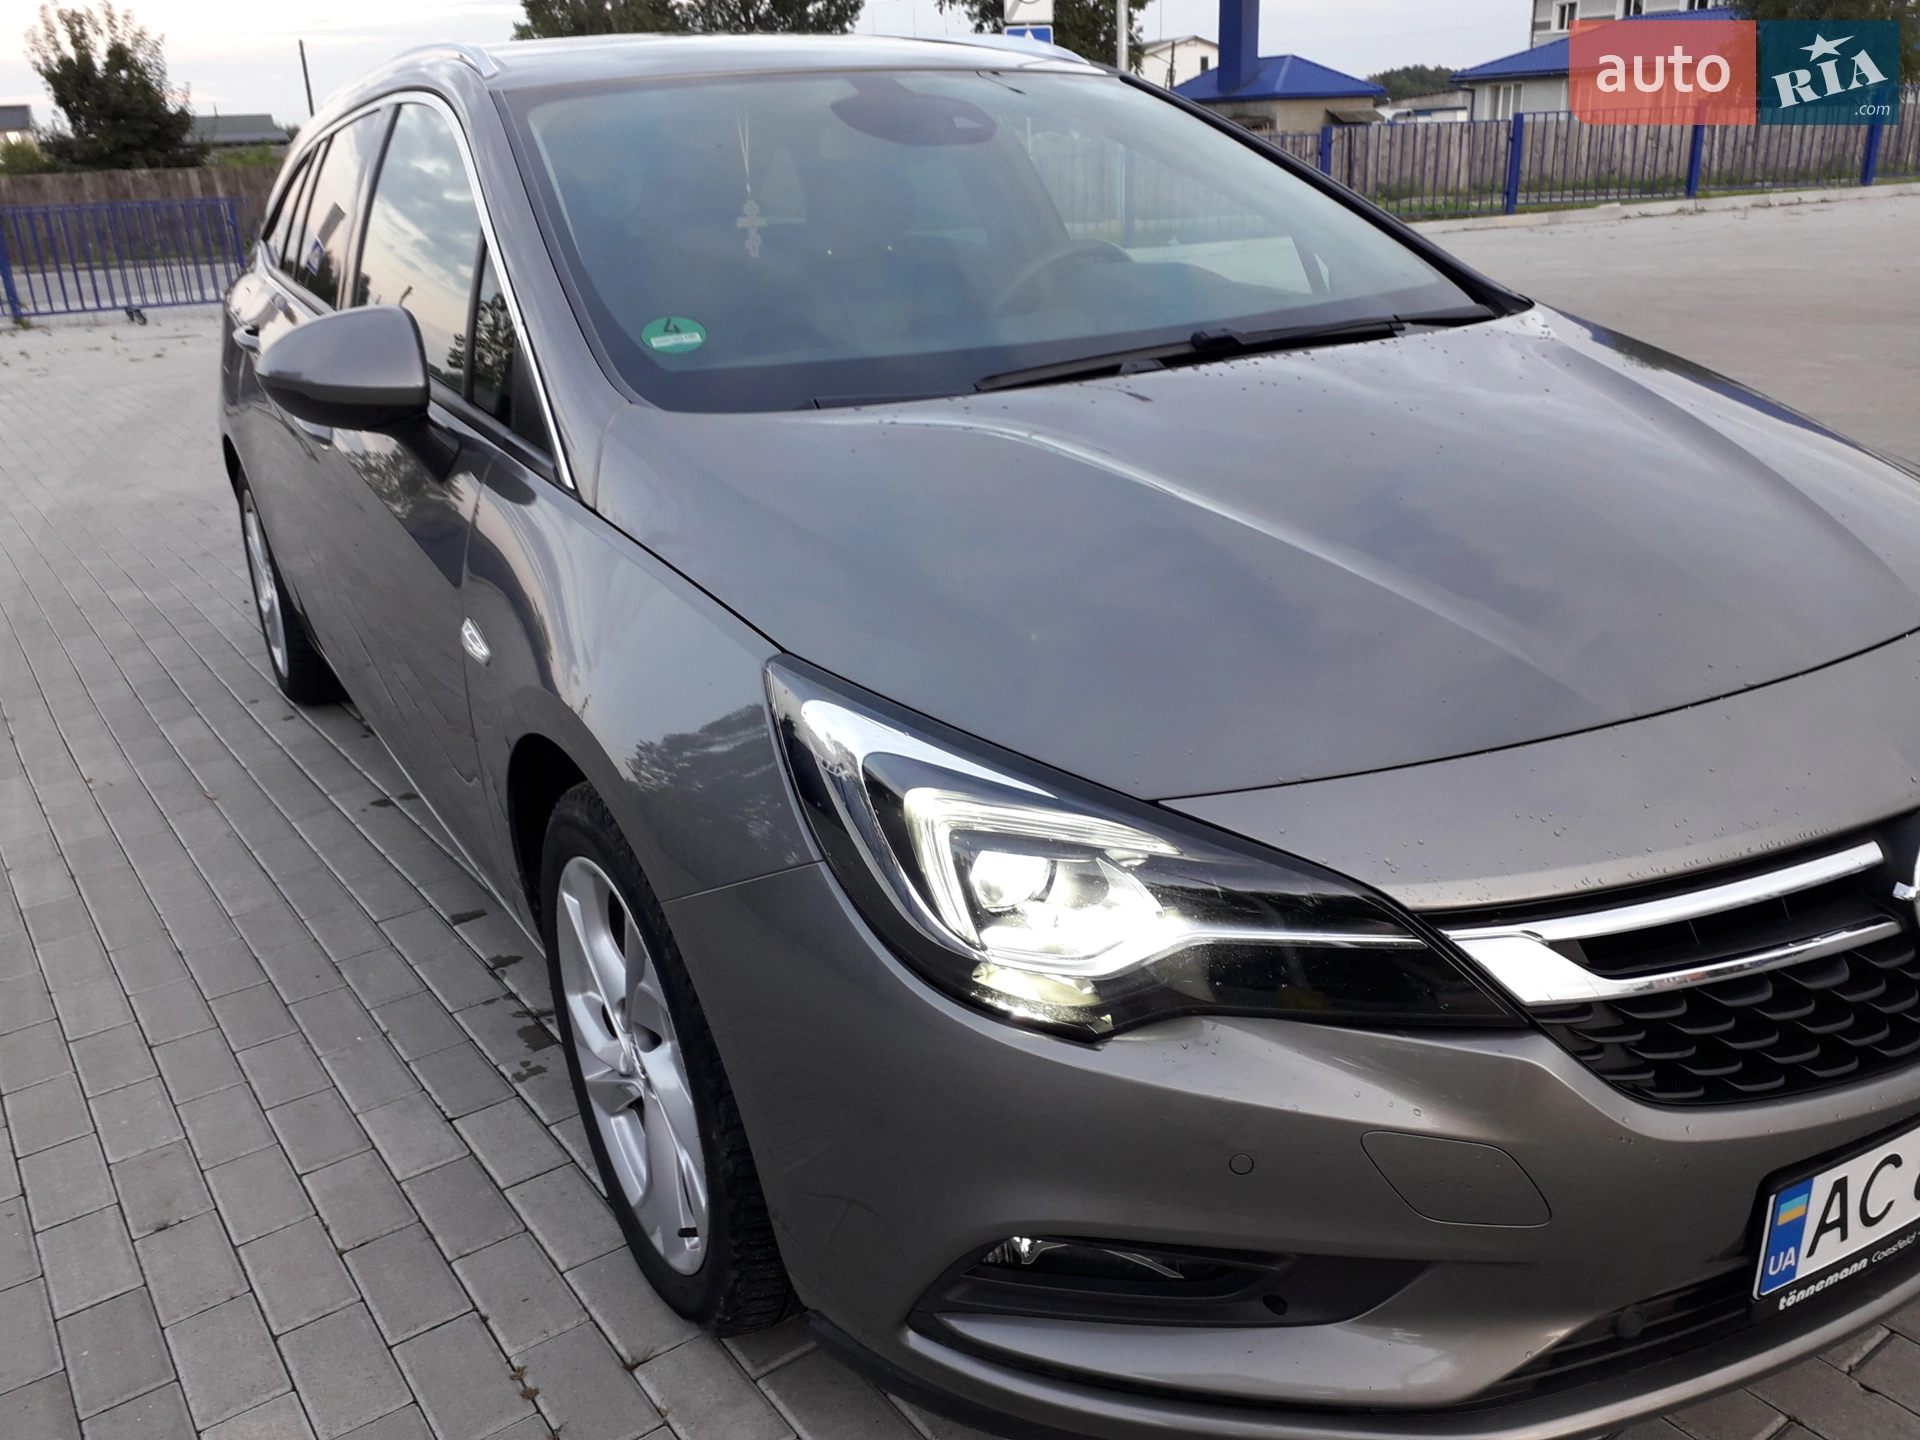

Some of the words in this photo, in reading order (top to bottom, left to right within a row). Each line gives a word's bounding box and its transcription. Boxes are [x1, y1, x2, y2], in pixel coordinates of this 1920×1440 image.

[663, 318, 682, 333] 4
[1768, 1246, 1796, 1276] UA
[1778, 1257, 1868, 1311] tönnemann
